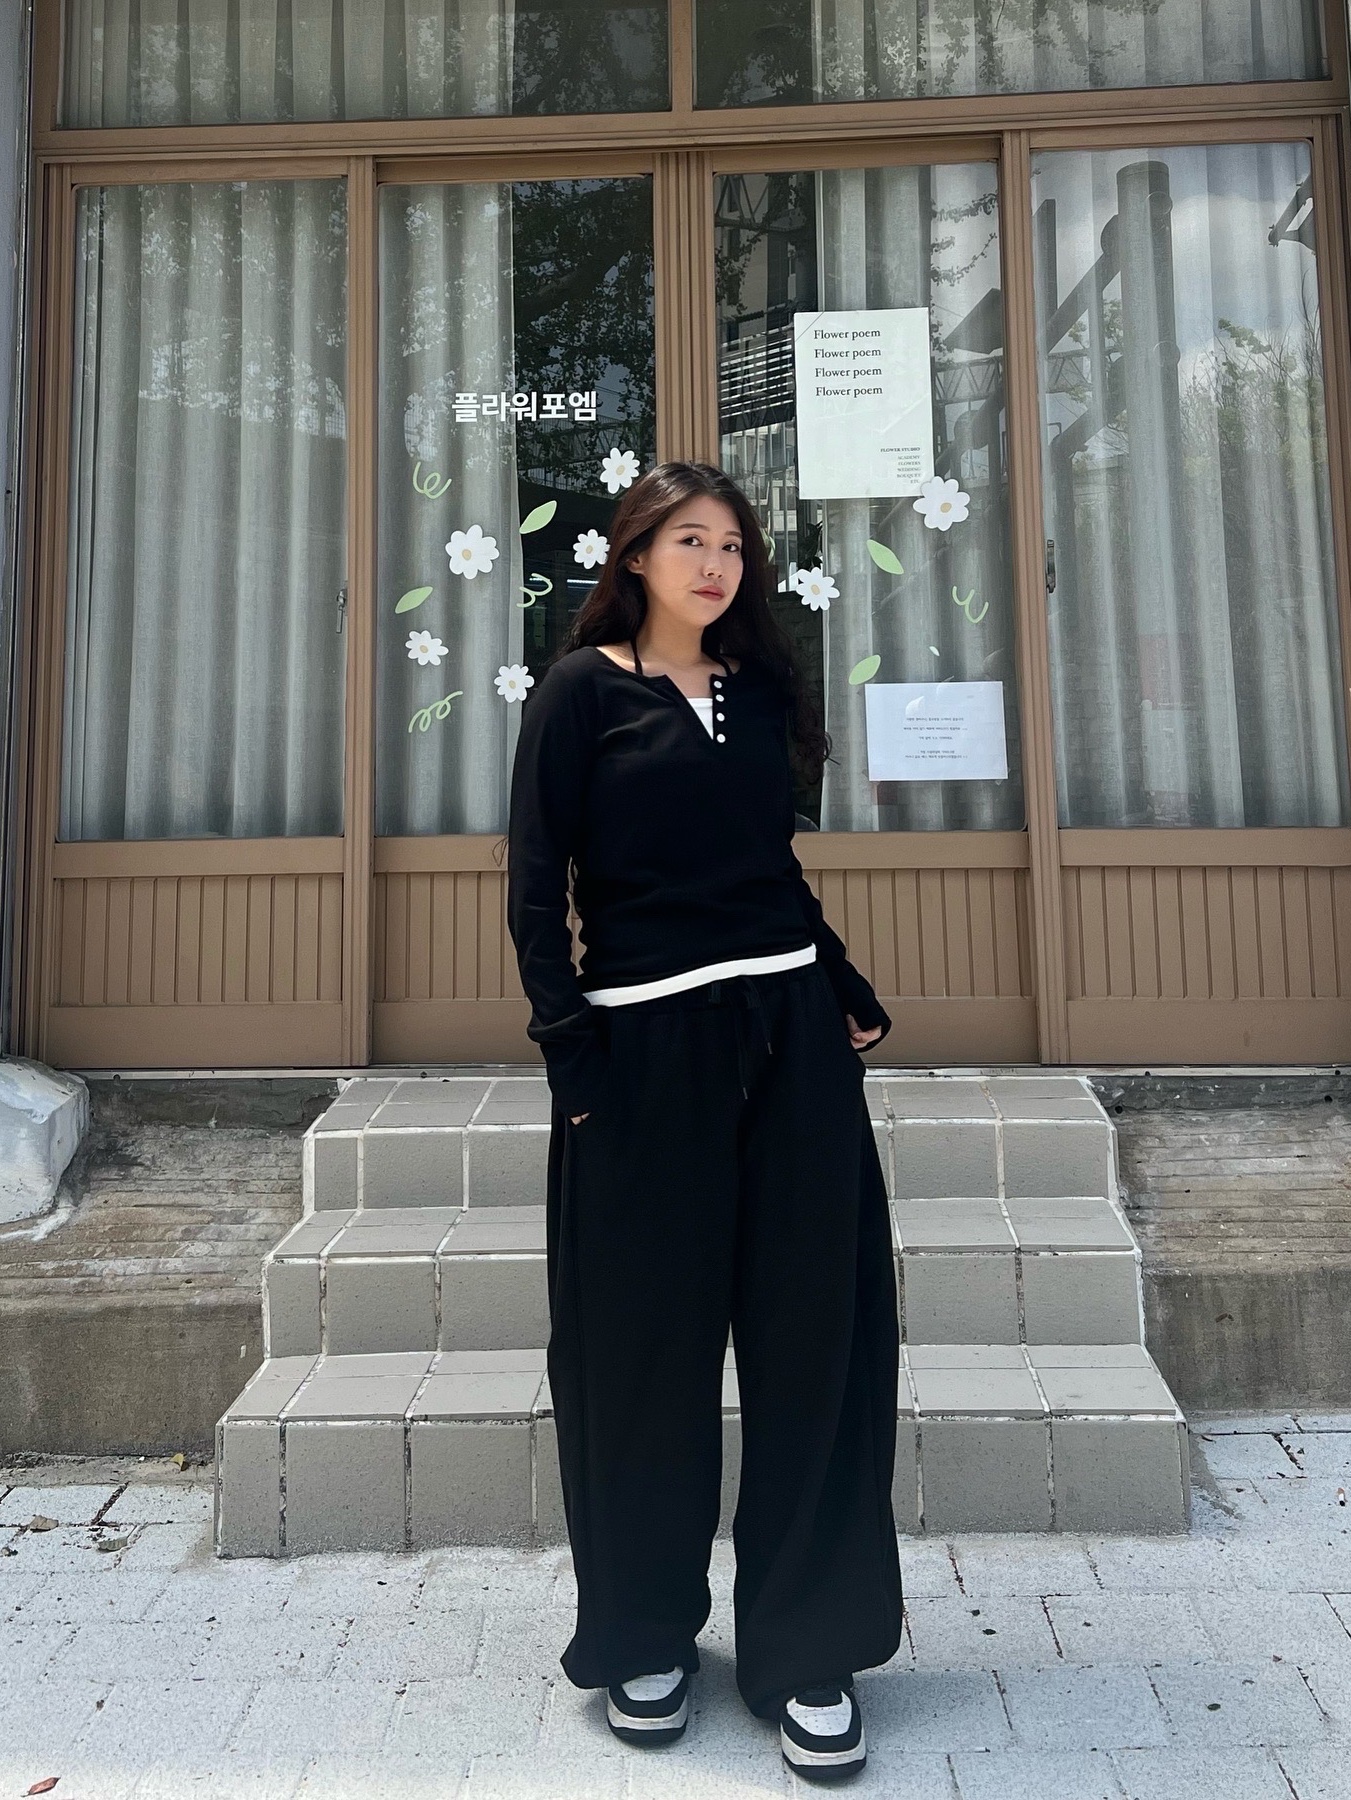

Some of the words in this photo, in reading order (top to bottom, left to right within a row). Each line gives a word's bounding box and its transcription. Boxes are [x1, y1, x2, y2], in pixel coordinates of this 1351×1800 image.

[814, 330, 849, 339] Flower
[852, 330, 881, 341] poem
[814, 349, 850, 358] Flower
[852, 349, 881, 360] poem
[815, 368, 850, 377] Flower
[853, 368, 882, 379] poem
[816, 387, 851, 396] Flower
[853, 387, 883, 398] poem
[451, 391, 597, 423] 플라워포엠
